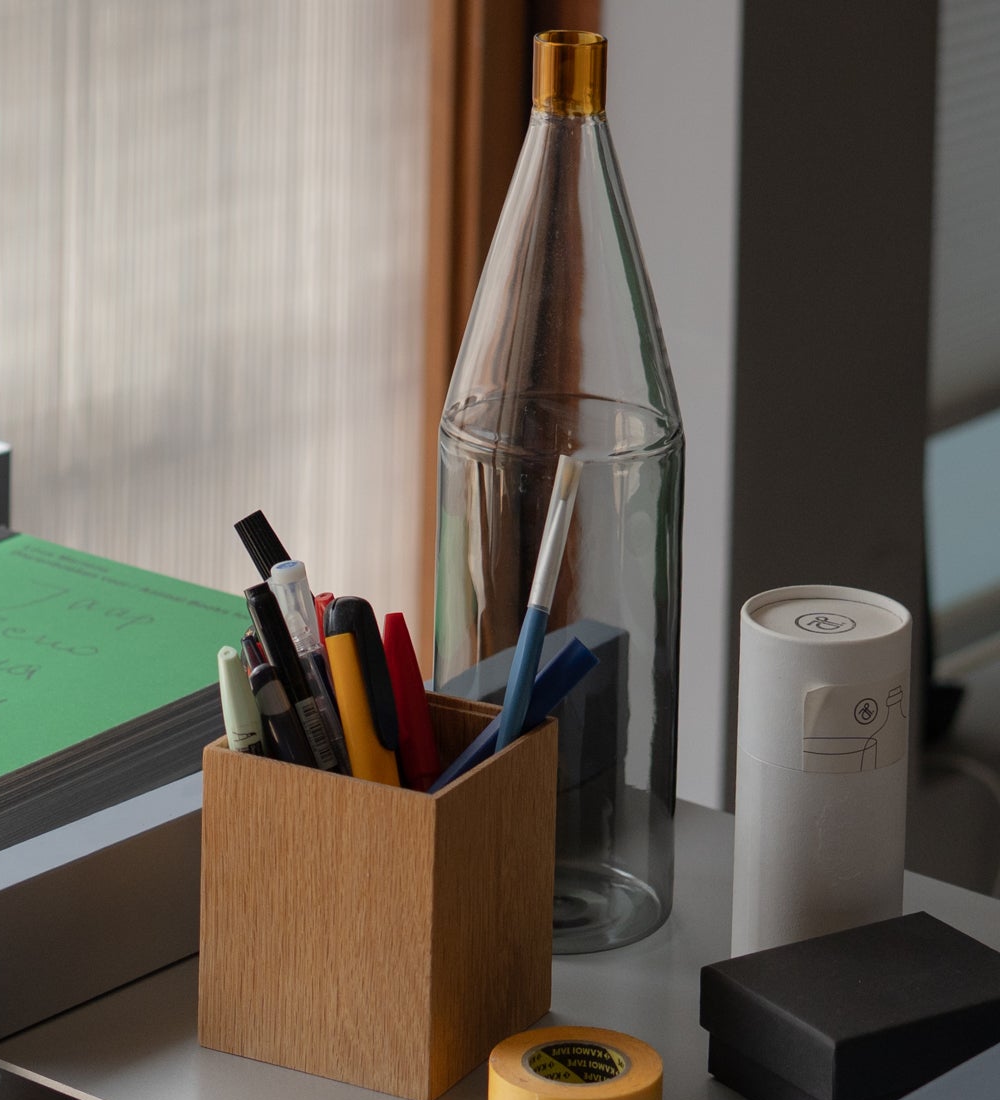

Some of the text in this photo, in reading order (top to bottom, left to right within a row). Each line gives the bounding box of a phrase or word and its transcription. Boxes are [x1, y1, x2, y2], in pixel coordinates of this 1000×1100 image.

[551, 1046, 604, 1059] KAMOI TAPE
[567, 1058, 588, 1068] TAPE
[588, 1060, 616, 1075] KAMOI
